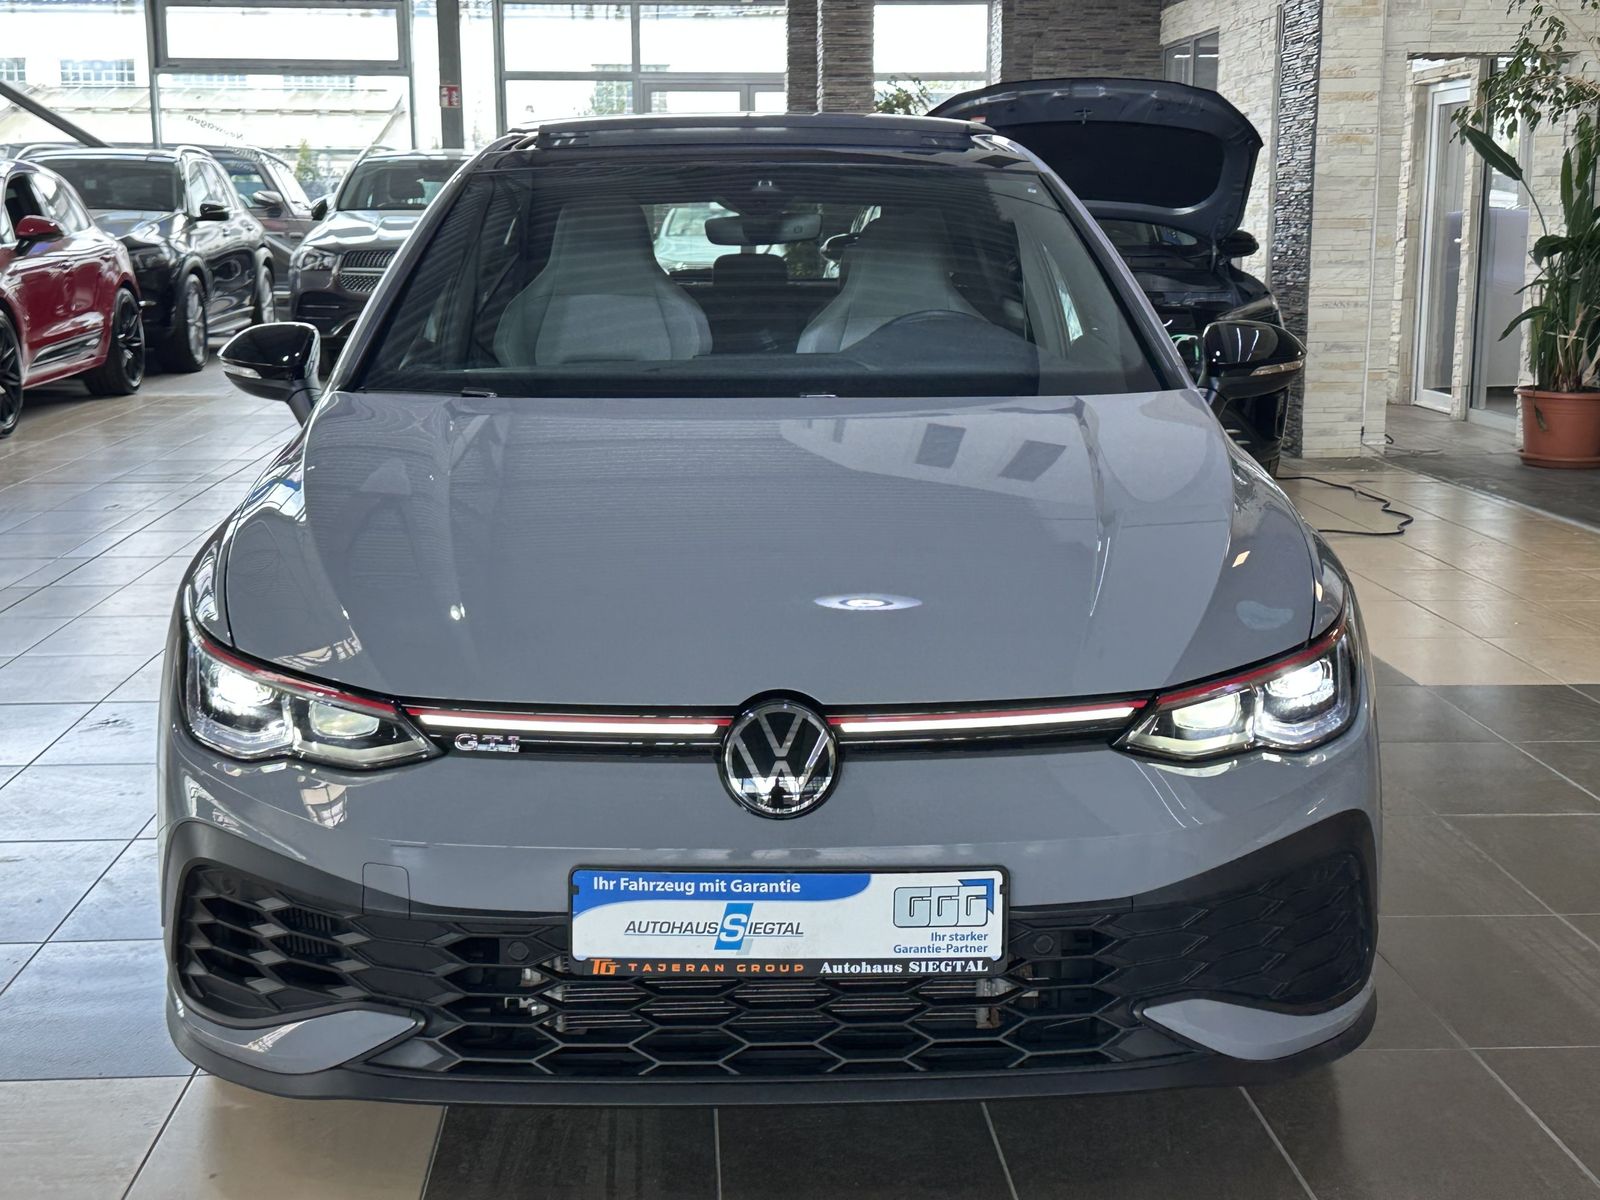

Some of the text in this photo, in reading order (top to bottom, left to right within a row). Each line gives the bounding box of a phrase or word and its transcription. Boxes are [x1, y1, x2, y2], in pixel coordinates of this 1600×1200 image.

[454, 733, 520, 752] GTI
[594, 876, 801, 895] Ihr Fahrzeug mit Garantie
[624, 920, 718, 935] AUTOHAUS
[931, 931, 988, 941] Ihr starker
[893, 943, 988, 954] Garantie-Partner
[628, 963, 725, 972] TAJERAN
[736, 964, 804, 973] GROUP
[819, 960, 988, 974] Autohaus SIEGTAL
